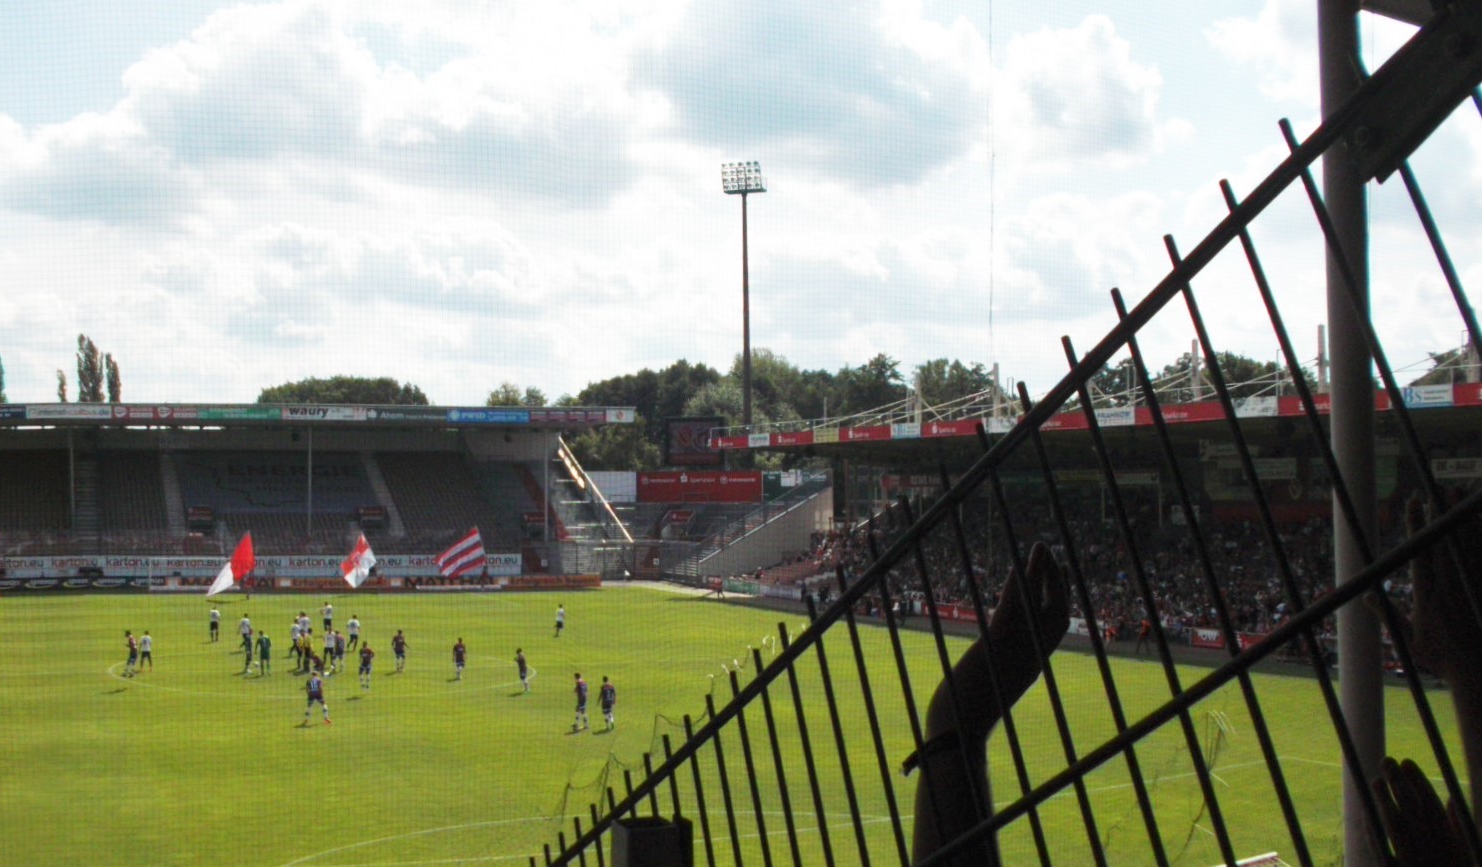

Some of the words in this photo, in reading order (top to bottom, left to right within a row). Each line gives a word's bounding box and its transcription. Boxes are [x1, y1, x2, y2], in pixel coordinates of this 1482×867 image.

[289, 406, 329, 418] waury
[253, 556, 282, 567] on.eu
[486, 554, 518, 566] on.eu
